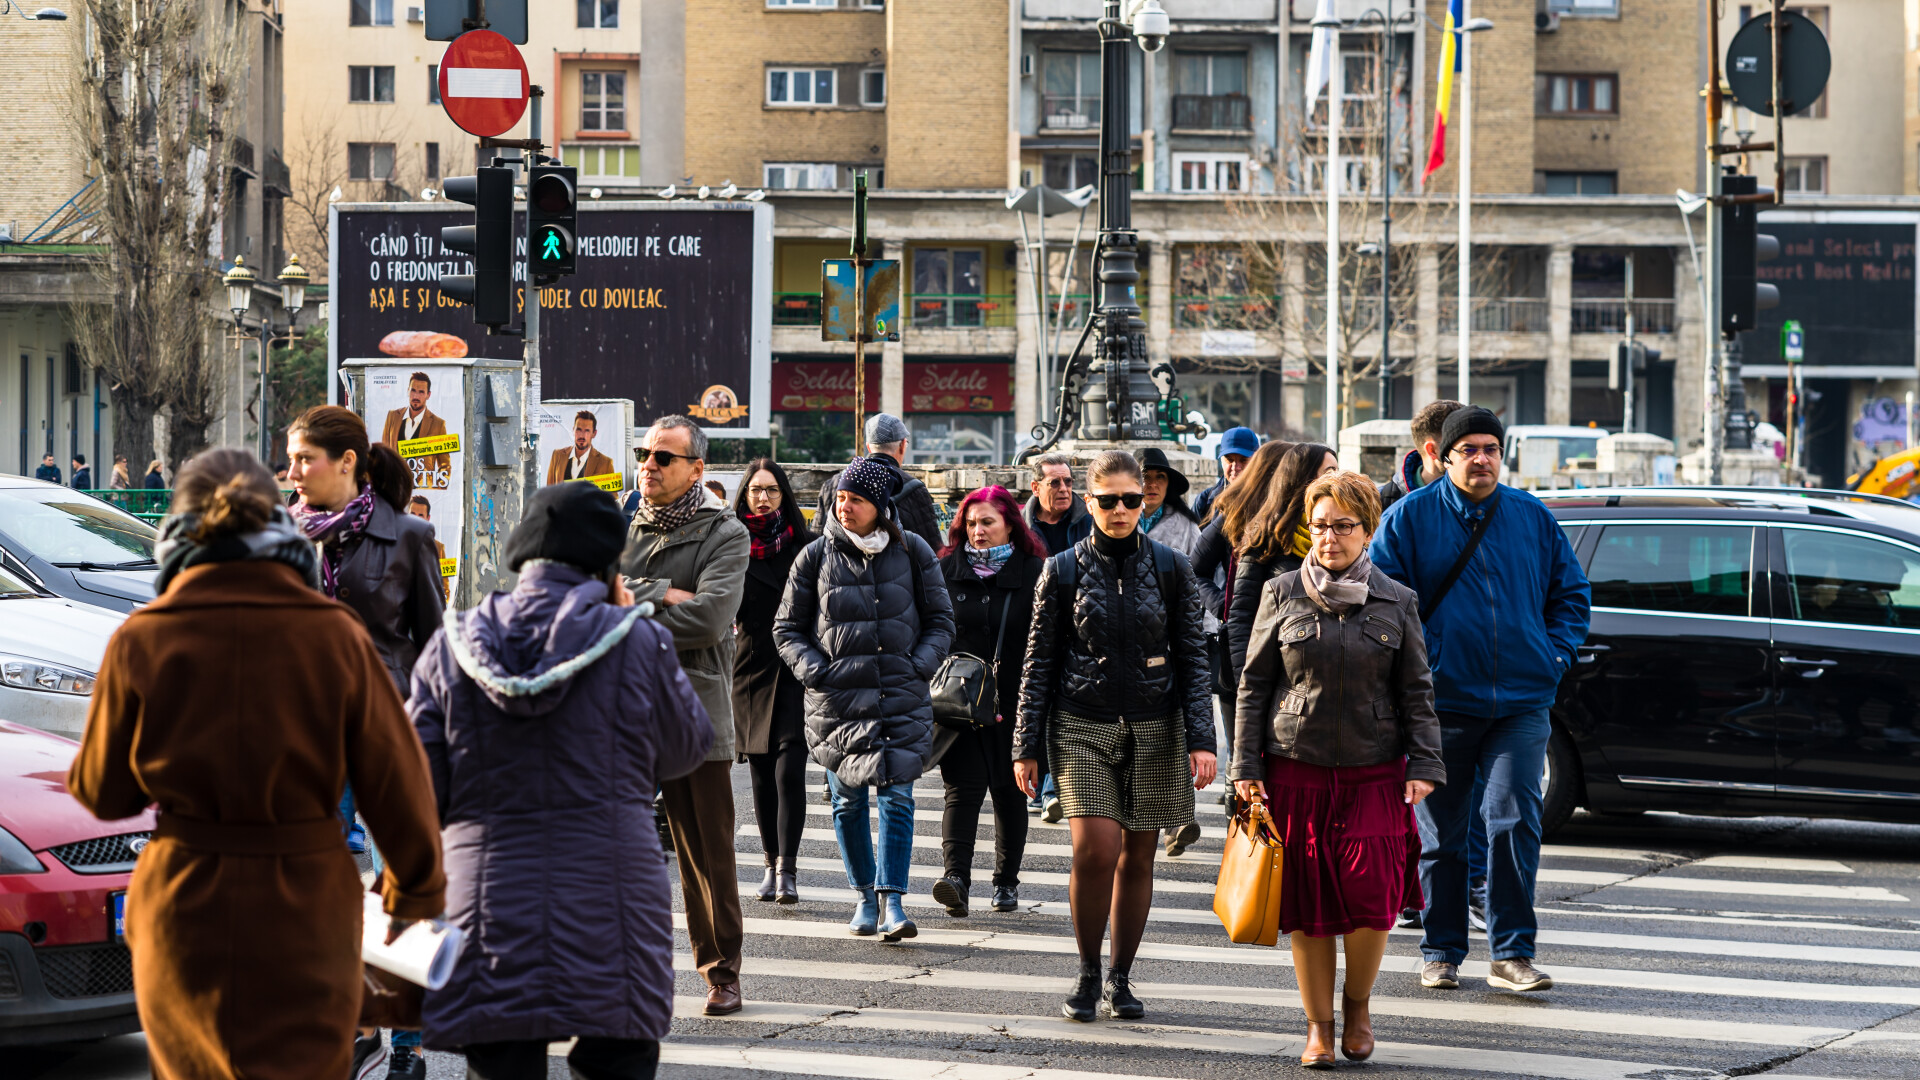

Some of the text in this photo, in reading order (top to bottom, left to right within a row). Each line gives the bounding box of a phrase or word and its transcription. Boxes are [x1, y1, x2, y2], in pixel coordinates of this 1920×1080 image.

[370, 232, 408, 257] CÂND
[577, 235, 702, 257] MELODIEI PE CARE
[1785, 238, 1814, 256] and
[1824, 238, 1882, 257] Select
[370, 261, 380, 281] O
[1814, 262, 1853, 280] Boot
[1862, 262, 1911, 281] Media
[402, 288, 410, 308] E
[580, 288, 597, 308] CU
[604, 287, 667, 309] DOVLEAC.
[400, 441, 458, 456] 26 februarie, ora 19:30
